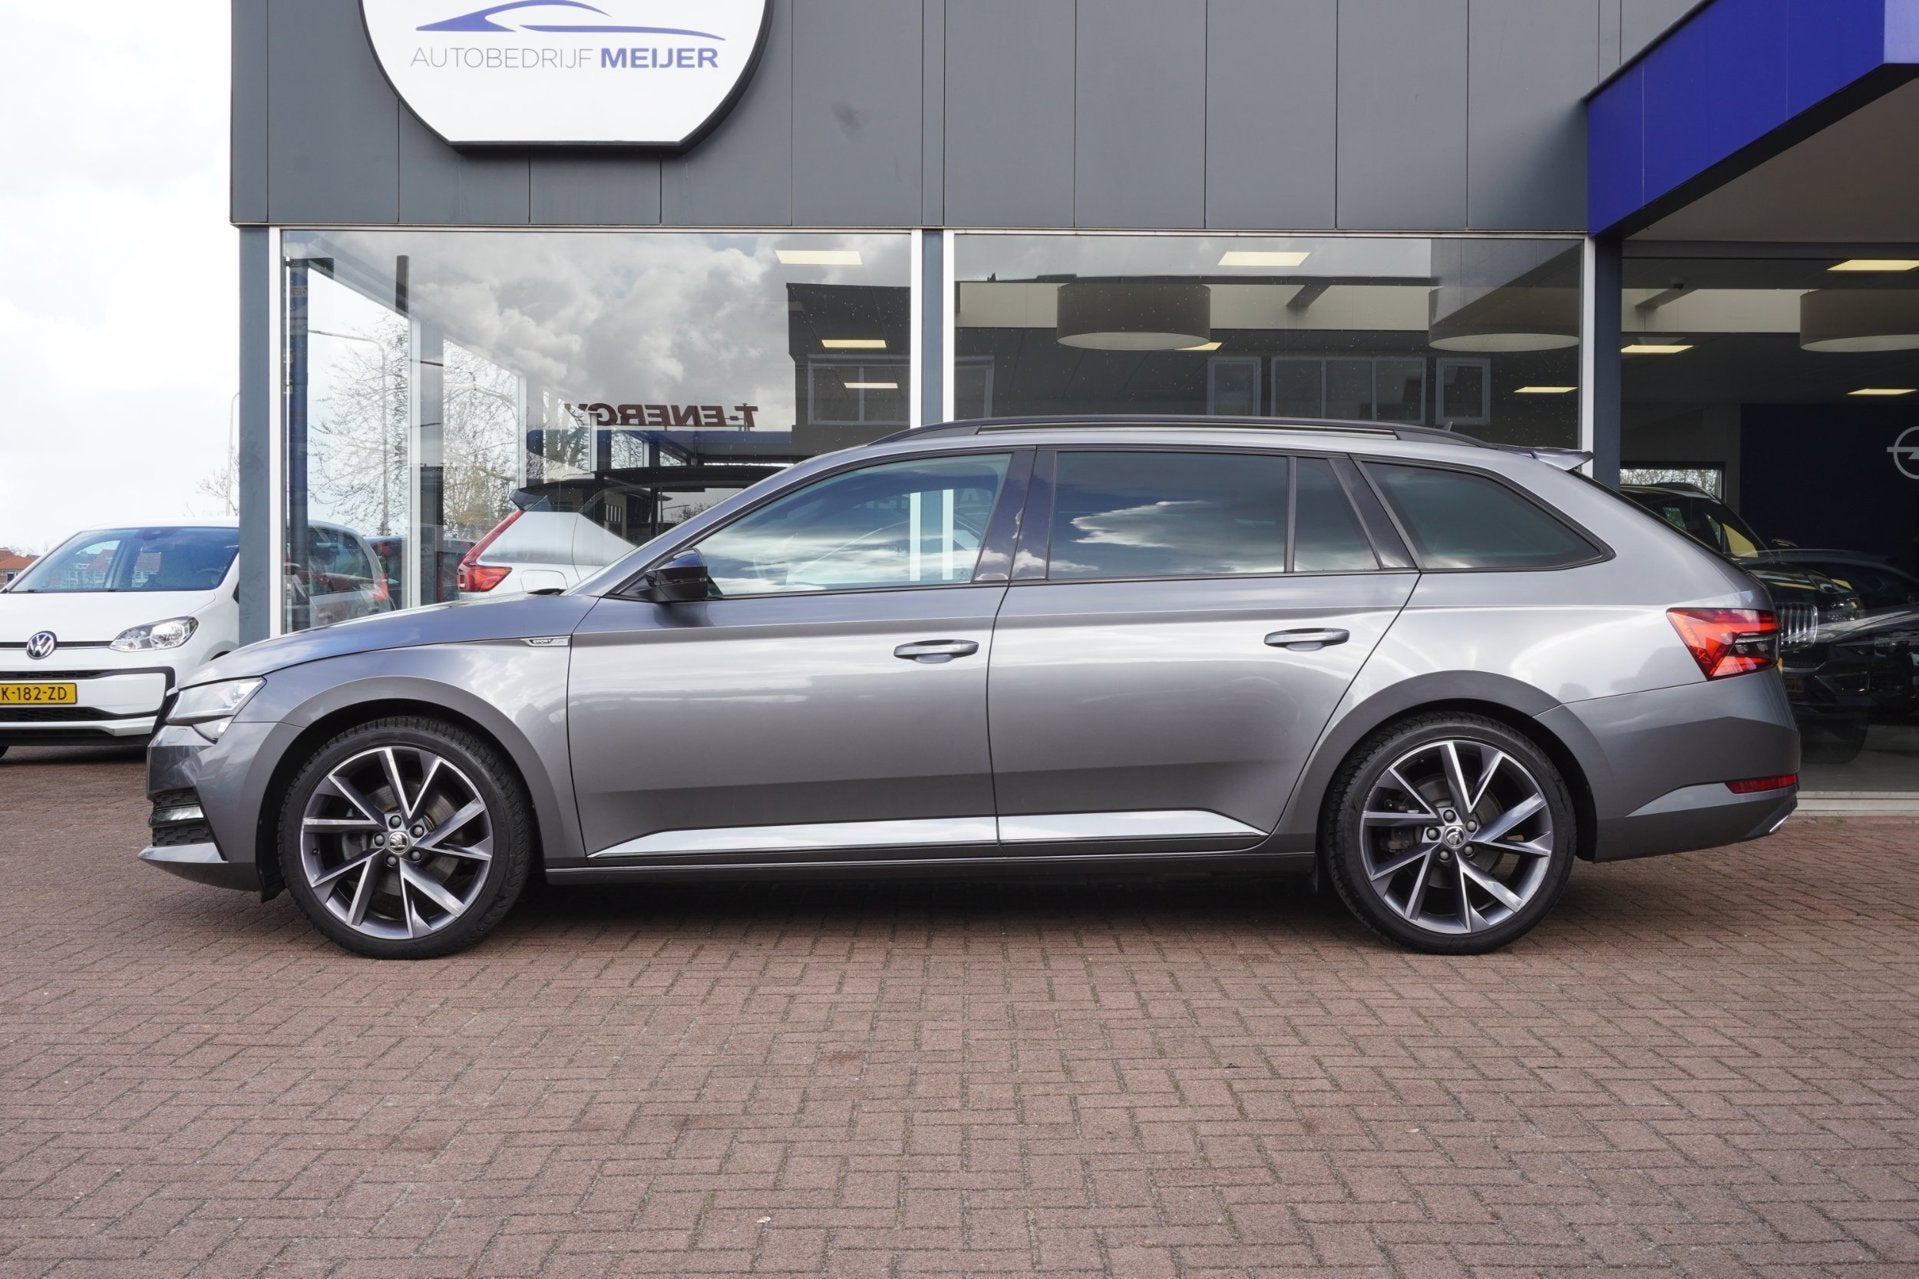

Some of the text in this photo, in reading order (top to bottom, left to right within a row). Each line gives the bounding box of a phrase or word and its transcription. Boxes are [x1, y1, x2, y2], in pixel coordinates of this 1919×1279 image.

[411, 47, 719, 69] AUTOBEDRIJF MEIJER
[2, 687, 67, 701] K-182-ZD
